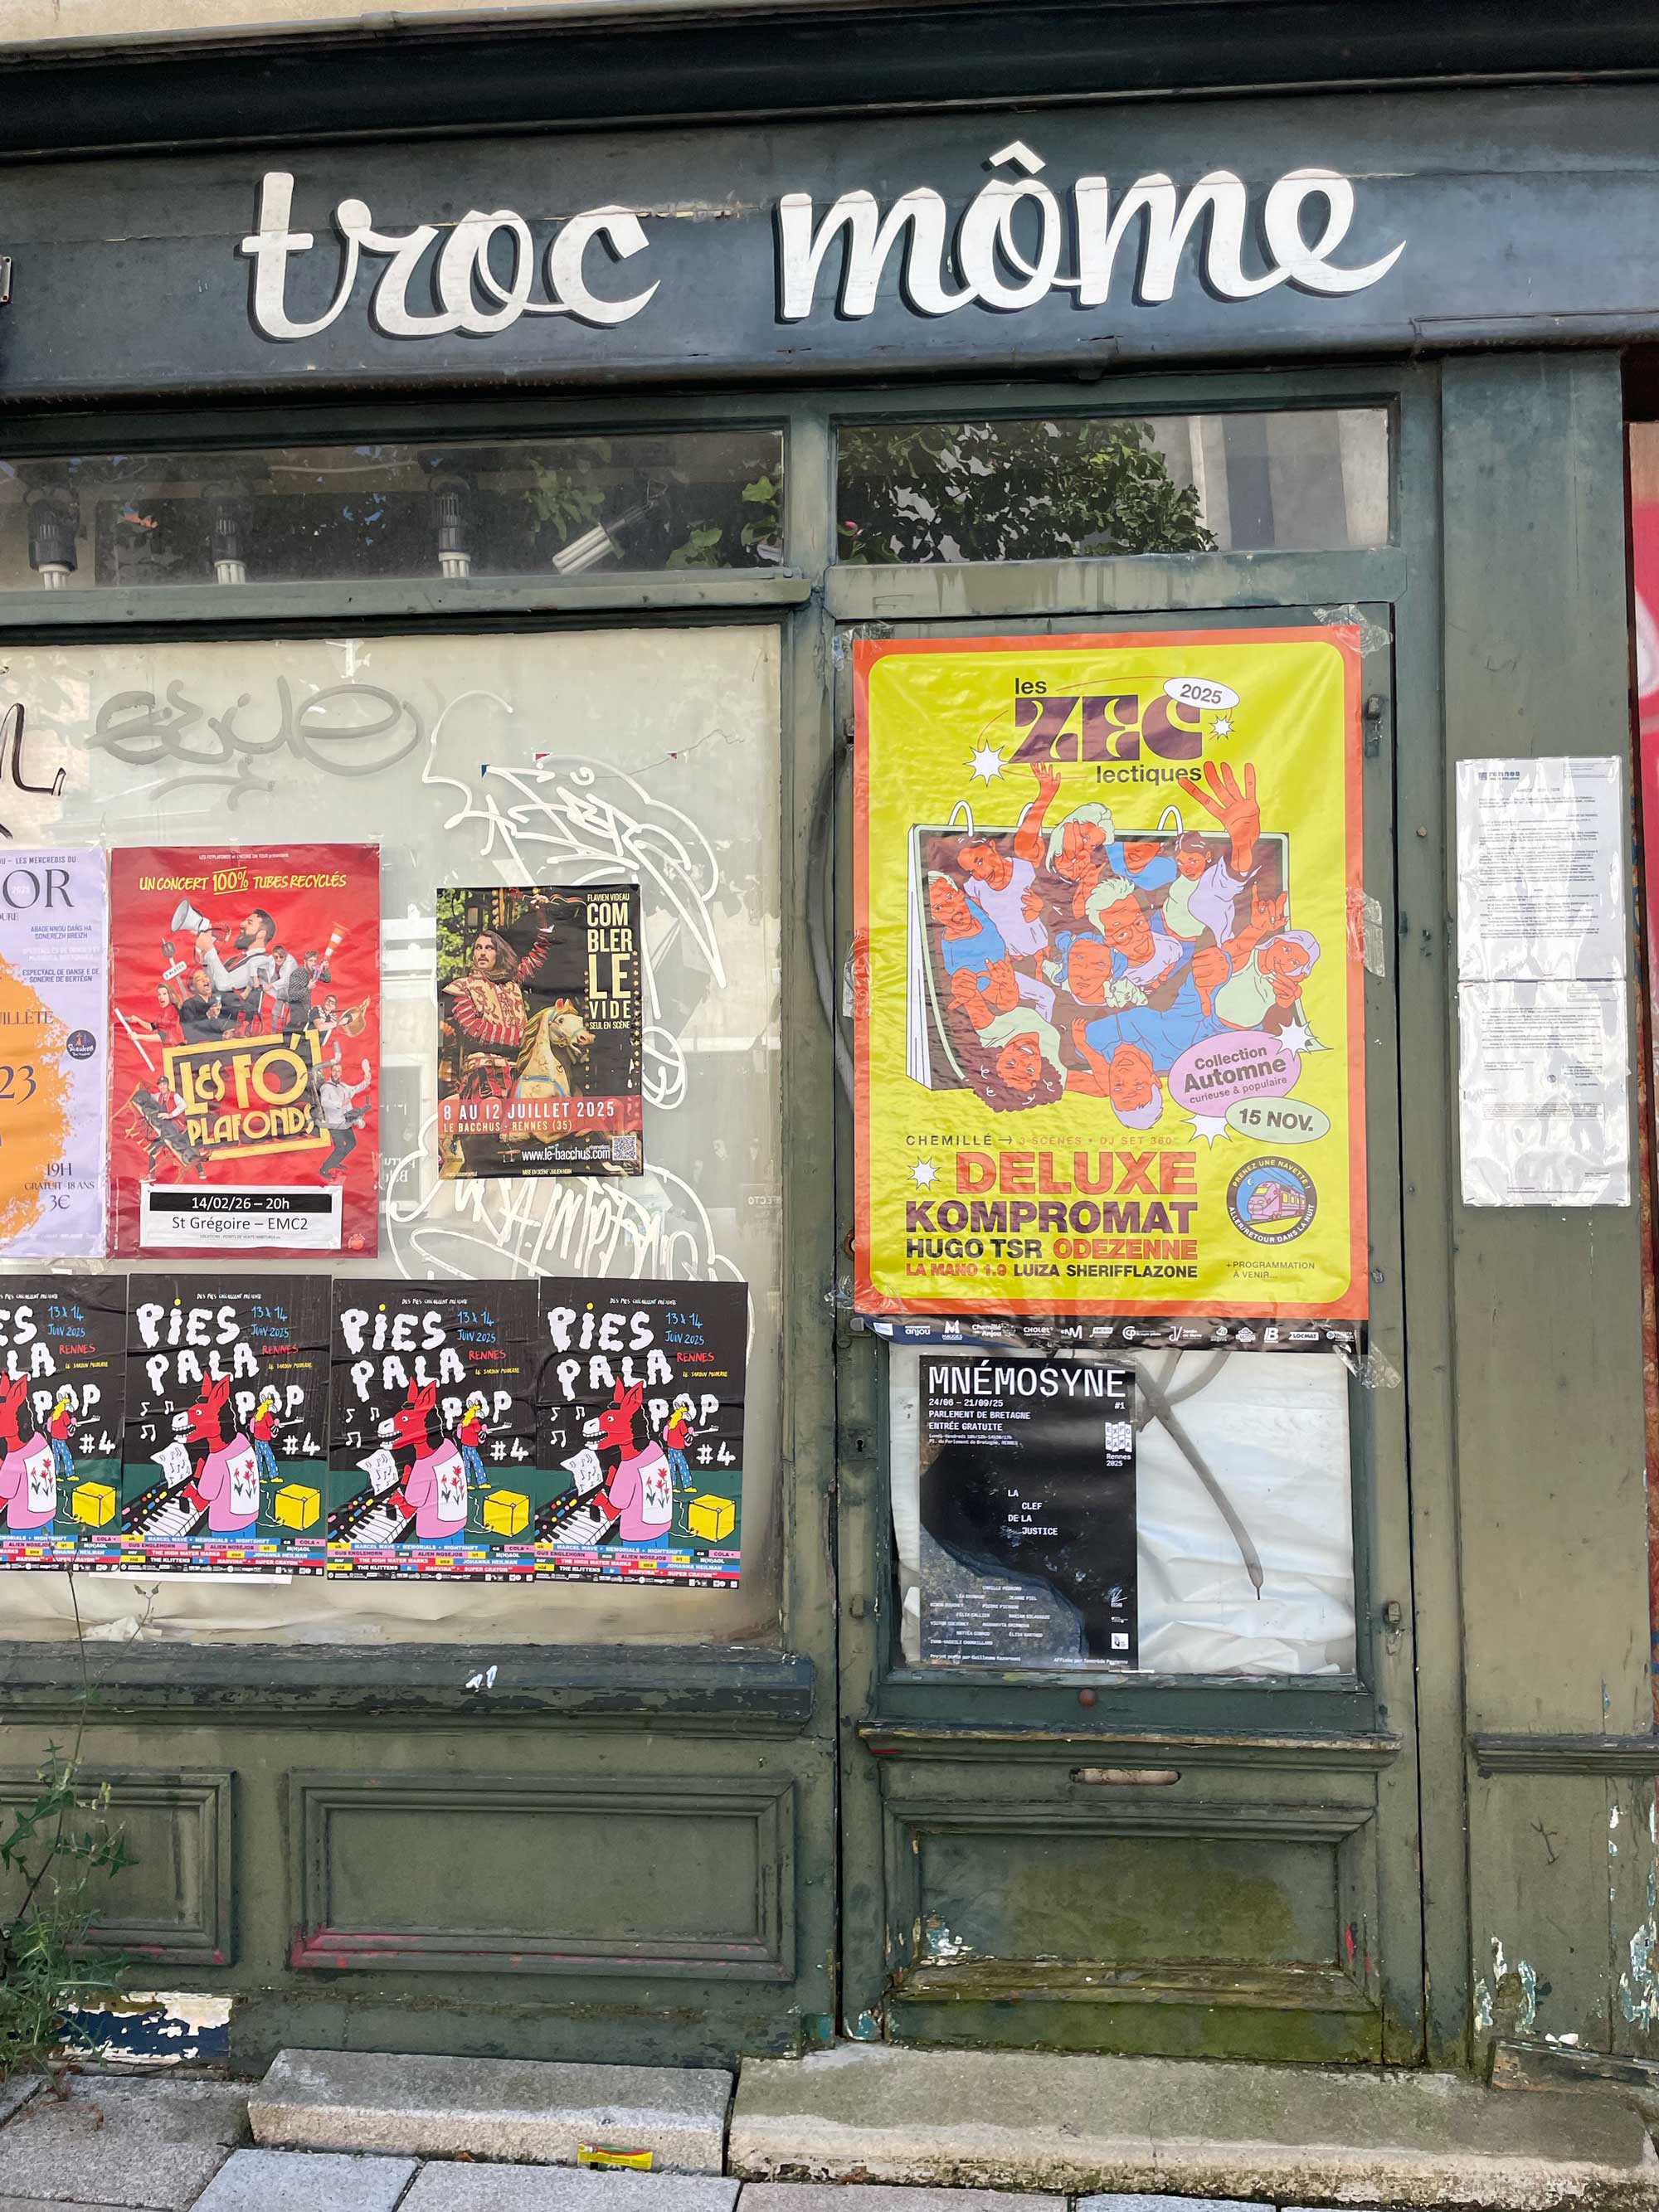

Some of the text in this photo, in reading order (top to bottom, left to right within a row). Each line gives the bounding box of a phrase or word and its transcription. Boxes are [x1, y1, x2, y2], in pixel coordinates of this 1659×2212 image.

[240, 139, 1408, 342] troc môme
[1014, 677, 1224, 705] les 2025
[1096, 765, 1203, 784] lectiques
[29, 856, 66, 864] MERCREDIS
[67, 855, 76, 863] DU
[139, 869, 348, 892] UN CONCERT 100% TUBES RECYCLÉS
[587, 892, 630, 902] FLAVIEN VIDEAU
[586, 902, 629, 927] COM
[587, 928, 633, 953] BLER
[588, 953, 631, 999] LE
[589, 1000, 631, 1020] VIDE
[589, 1019, 630, 1030] SEUL EN SCÈNE
[1194, 1046, 1267, 1071] Collection
[0, 1064, 36, 1106] 23
[1184, 1057, 1287, 1094] Automne
[1189, 1077, 1287, 1105] curieuse & populaire
[444, 1101, 615, 1121] 8 AU 12 JUILLET 2025
[1239, 1107, 1314, 1132] 15 NOV.
[187, 1101, 317, 1147] PLAFONDS
[443, 1119, 572, 1133] LE BACCHUS RENNES (35)
[906, 1133, 992, 1146] CHEMILLÉ
[1099, 1136, 1115, 1145] DJ
[1121, 1136, 1144, 1145] SET
[521, 1146, 611, 1162] www.le-bacchus.com
[46, 1162, 72, 1177] 19H
[956, 1151, 1198, 1195] DELUXE
[1232, 1163, 1258, 1188] PRENEZ
[1278, 1159, 1309, 1186] NAVETTE
[77, 1181, 95, 1189] ANS
[49, 1194, 71, 1212] 3€
[191, 1196, 289, 1212] 14/02/26 20h
[172, 1216, 309, 1232] St Grégoire EMC2
[905, 1199, 1199, 1234] KOMPROMAT
[1228, 1203, 1315, 1243] ALLER/RETOUR DANS LA NUIT
[906, 1237, 1199, 1261] HUGO TSR ODEZENNE
[906, 1263, 1199, 1279] LA MANO 1.9 LUIZA SHERIFFLAZONE
[971, 1323, 1002, 1332] Chemillé
[59, 1343, 96, 1355] RENNES
[261, 1344, 299, 1355] RENNES
[468, 1349, 507, 1361] RENNES
[676, 1352, 715, 1363] RENNES
[145, 1342, 260, 1397] PALA
[350, 1348, 467, 1403] PALA
[556, 1349, 674, 1402] PALA
[928, 1360, 1126, 1398] MNÉMOSYNE
[928, 1410, 1031, 1420] PARLEMENT DE BRETAGNE
[1114, 1401, 1126, 1410] #1
[928, 1422, 1003, 1432] ENTRÉE GRATUITE
[79, 1429, 116, 1455] #4
[282, 1431, 321, 1456] #4
[489, 1437, 529, 1461] #4
[696, 1441, 737, 1466] #4
[1021, 1501, 1043, 1510] CLEF
[1007, 1514, 1032, 1523] DE LA
[1021, 1527, 1058, 1536] JUSTICE
